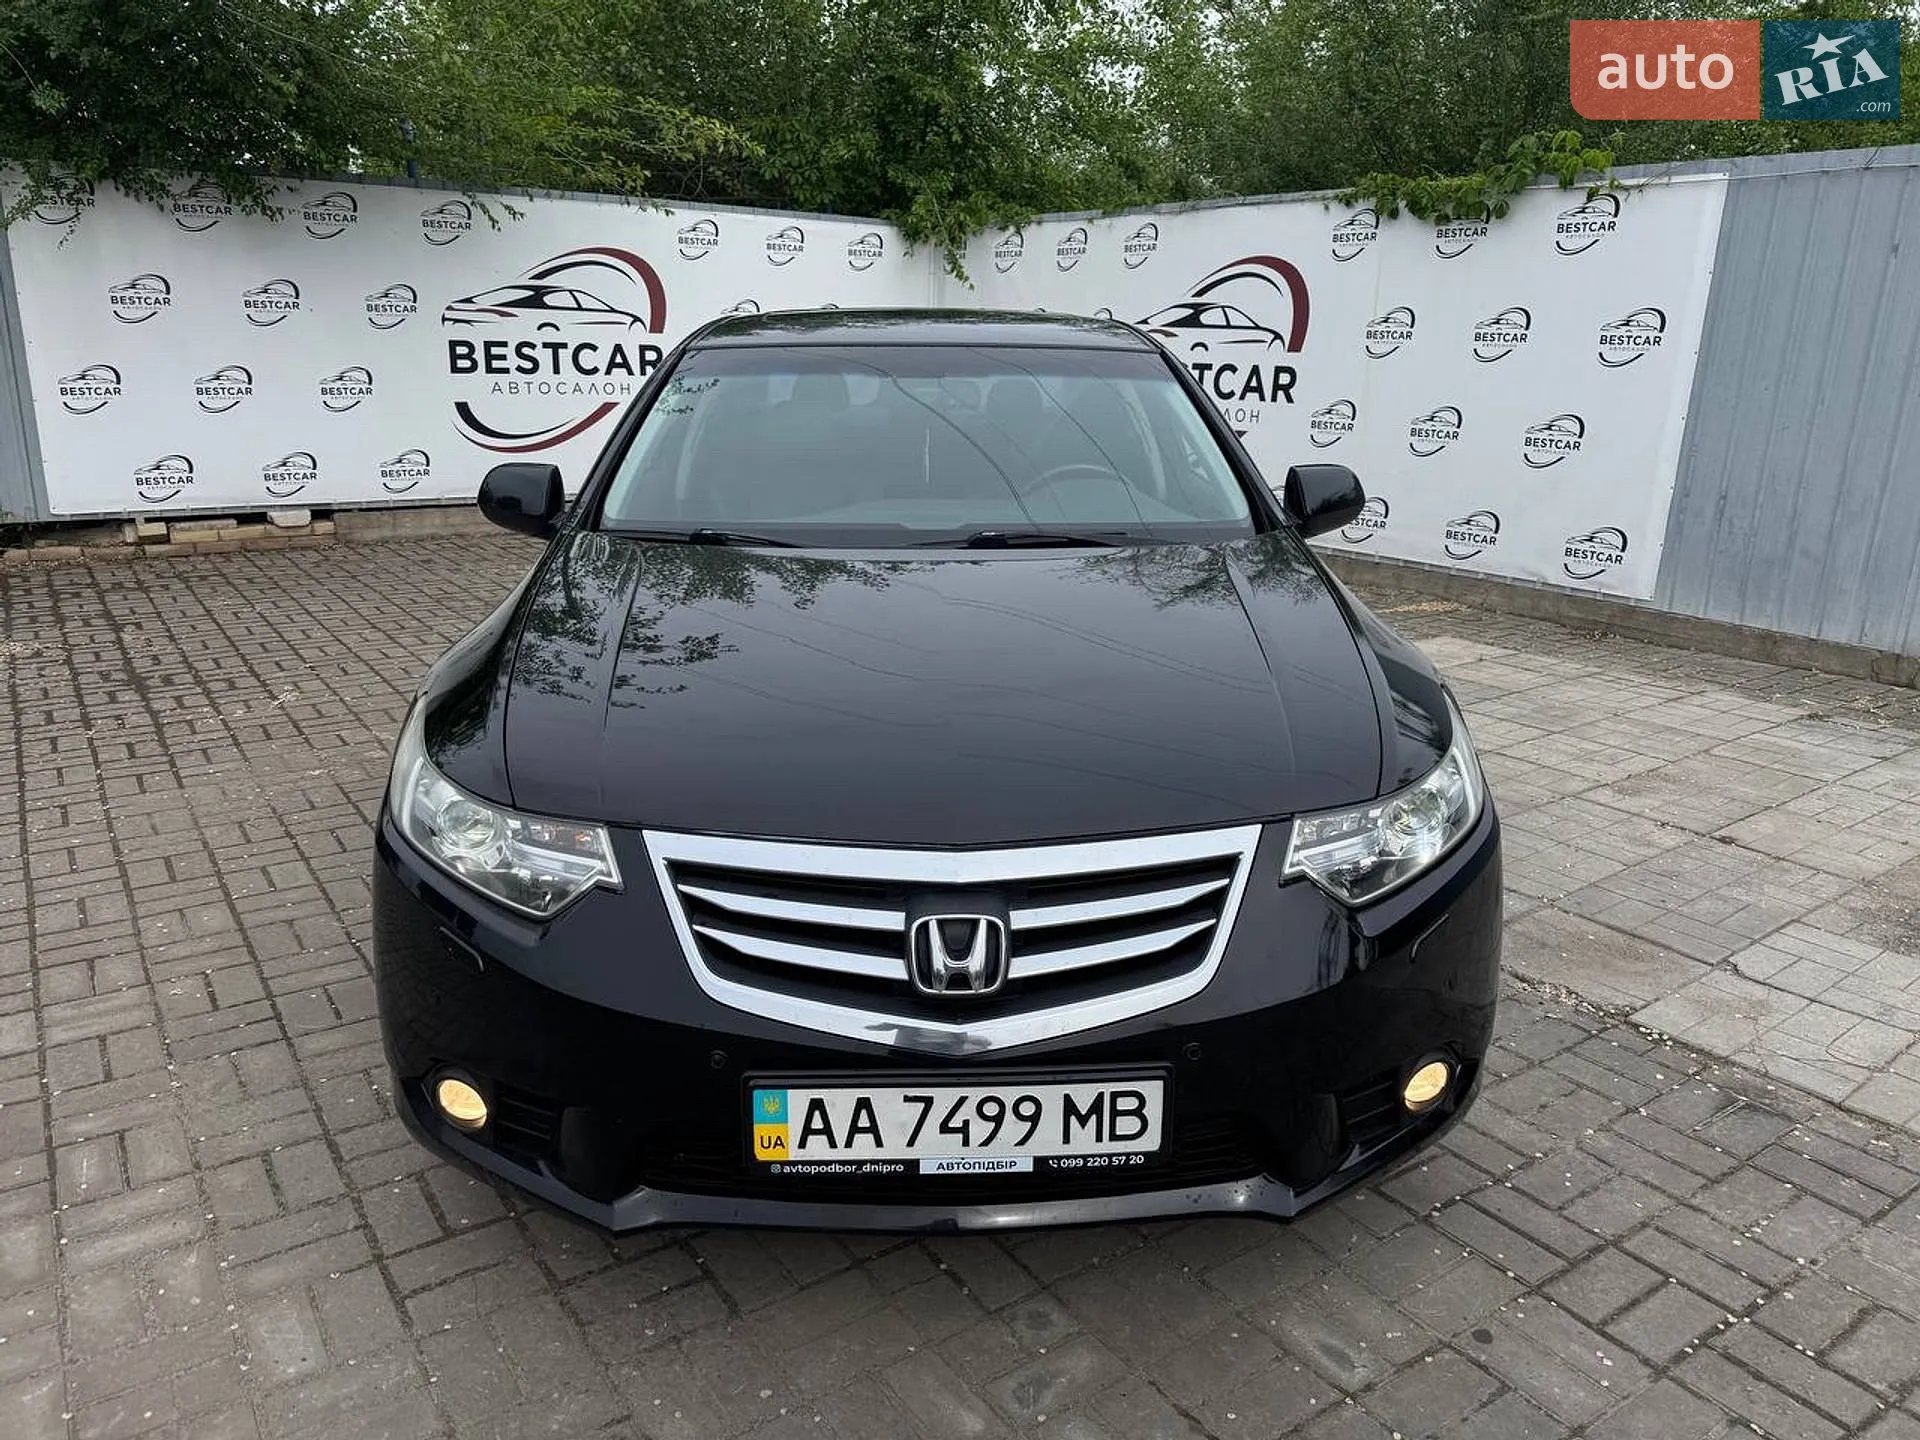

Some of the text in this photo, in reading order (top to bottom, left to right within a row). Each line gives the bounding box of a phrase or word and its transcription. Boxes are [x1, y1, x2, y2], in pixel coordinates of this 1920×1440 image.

[173, 203, 232, 215] BESTCAR
[304, 212, 357, 222] BESTCAR
[422, 219, 471, 229] BESTCAR
[1557, 221, 1616, 233] BESTCAR
[1333, 232, 1376, 242] BESTCAR
[1437, 227, 1487, 238] BESTCAR
[678, 237, 718, 245] BESTCAR
[767, 243, 803, 252] BESTCAR
[1057, 247, 1086, 256] BESTCAR
[1125, 243, 1156, 252] BESTCAR
[847, 248, 883, 258] BESTCAR
[995, 250, 1022, 258] BESTCAR
[111, 296, 170, 306] BESTCAR
[244, 300, 299, 309] BESTCAR
[367, 304, 416, 313] BESTCAR
[1367, 330, 1412, 340] BESTCAR
[1475, 332, 1527, 342] BESTCAR
[1600, 335, 1661, 345] BESTCAR
[448, 340, 665, 377] BESTCAR
[491, 381, 631, 396] АВТОСАЛОН
[1191, 364, 1298, 404] TCAR
[60, 387, 121, 395] BESTCAR
[197, 387, 252, 395] BESTCAR
[321, 387, 372, 395] BESTCAR
[1311, 420, 1353, 431] BESTCAR
[1410, 428, 1459, 440] BESTCAR
[1525, 437, 1580, 450] BESTCAR
[264, 473, 317, 481] BESTCAR
[381, 469, 429, 477] BESTCAR
[136, 476, 193, 485] BESTCAR
[1446, 530, 1496, 544] BESTCAR
[1565, 547, 1623, 564] BESTCAR
[798, 1090, 1149, 1150] AA 7499 MB
[760, 1134, 785, 1150] UA
[936, 1158, 1017, 1172] АВТОПІДБІР
[1060, 1155, 1145, 1168] 099 220 57 20
[783, 1162, 904, 1175] avtopodbor_dnipro
